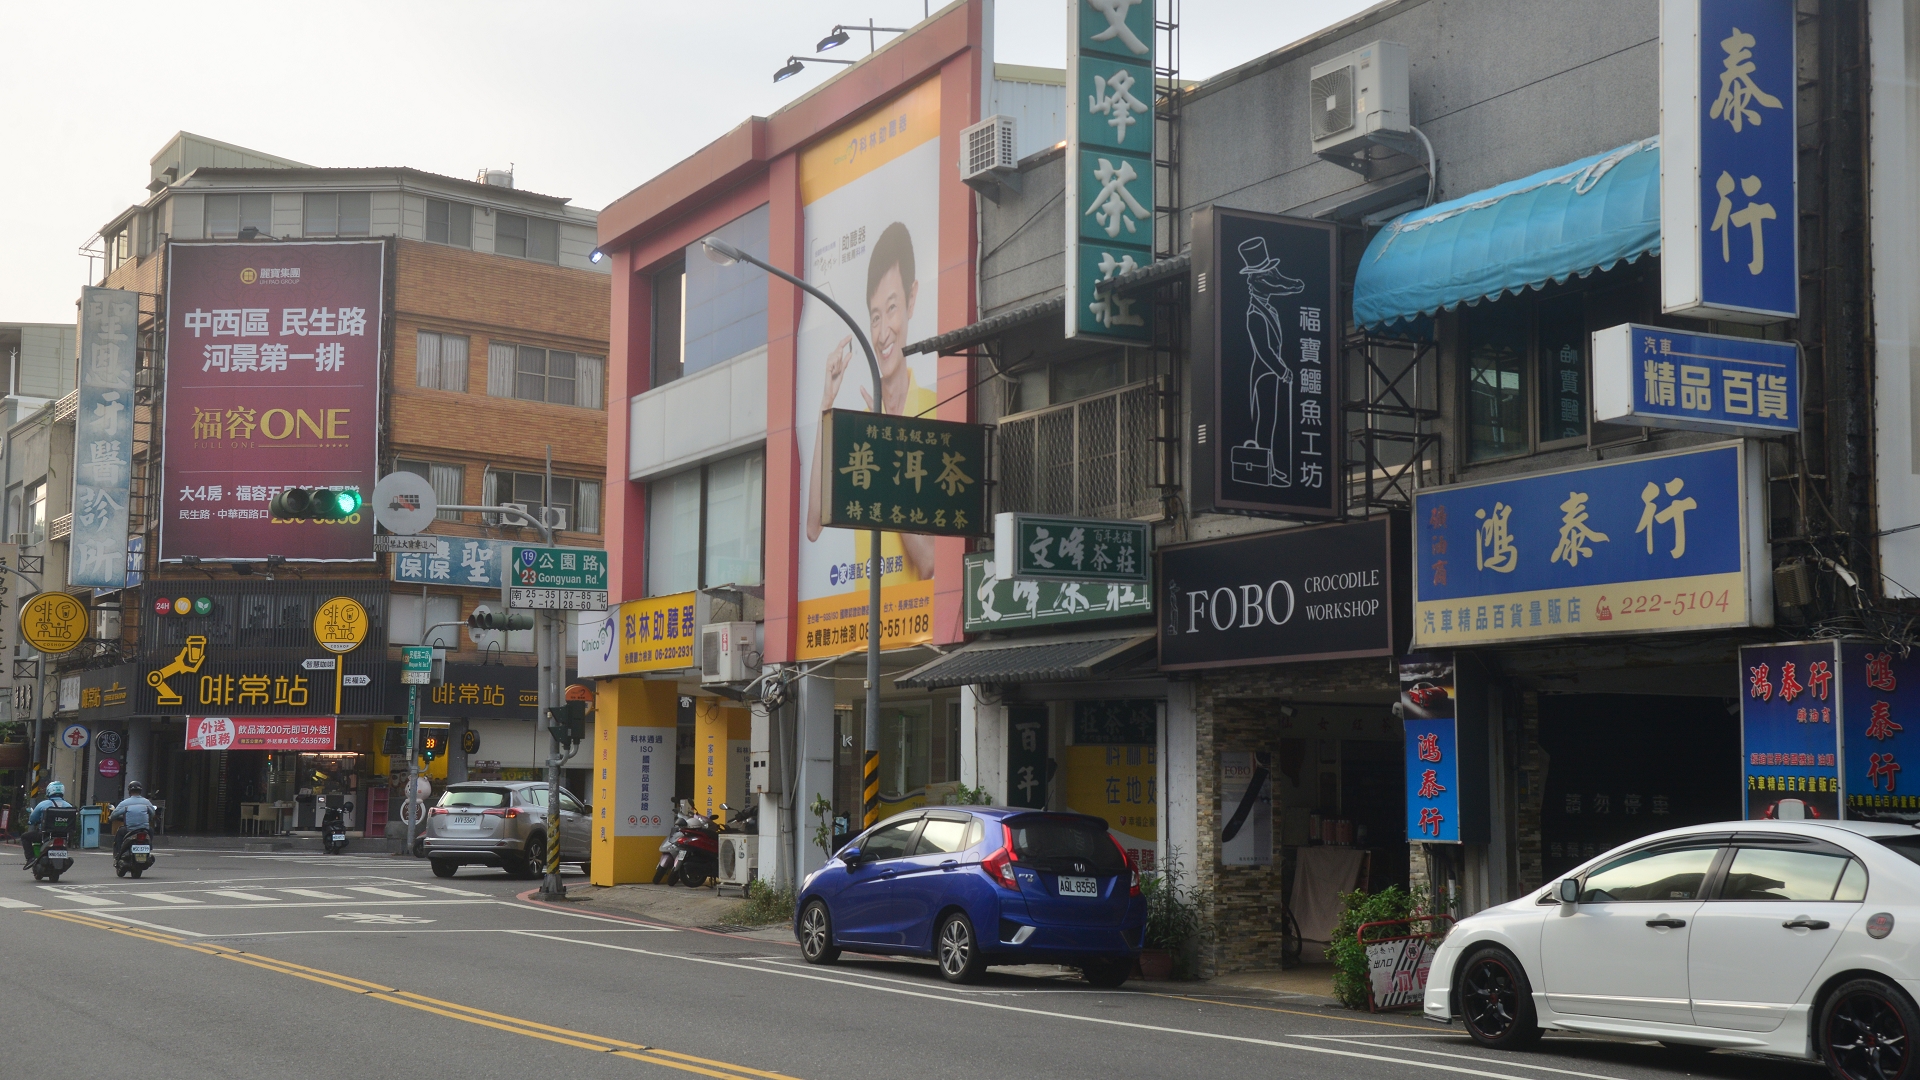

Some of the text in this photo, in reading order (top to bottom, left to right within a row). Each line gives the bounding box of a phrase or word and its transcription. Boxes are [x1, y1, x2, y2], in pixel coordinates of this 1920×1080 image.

[1709, 26, 1784, 276] 泰行
[184, 307, 367, 338] 中西區 民生路
[202, 343, 345, 373] 河景第一排
[1644, 336, 1672, 356] 汽車
[1300, 306, 1322, 489] 福寶鱷魚工坊
[1644, 360, 1789, 420] 精品 百貨
[866, 424, 952, 448] 精選高級品質
[839, 441, 975, 497] 普洱茶
[846, 500, 969, 530] 特選各地名茶
[1475, 477, 1698, 574] 鴻泰行
[524, 551, 534, 561] 19
[539, 553, 599, 571] 公園路
[521, 569, 537, 584] 23
[538, 572, 599, 585] Gongyuan Rd.
[1304, 569, 1380, 594] CROCODILE
[156, 602, 170, 610] 24H
[512, 589, 522, 600] 南
[596, 593, 606, 603] 北
[1621, 589, 1730, 617] 222-5104
[1186, 580, 1295, 634] FOBO
[1305, 598, 1380, 621] WORKSHOP
[1423, 596, 1582, 635] 汽車精品百貨量販店
[625, 604, 694, 646] 科林助聽器
[806, 621, 857, 648] 免費聽力檢測
[859, 613, 929, 641] 080-551188
[654, 644, 693, 661] 06-220-2931
[200, 674, 308, 706] 啡常站
[1750, 660, 1833, 702] 鴻泰行
[432, 682, 505, 706] 啡常站
[201, 719, 226, 734] 外送
[238, 725, 332, 735] 飲品滿200元即可外送!
[1864, 651, 1904, 792] 鴻泰行
[205, 732, 231, 748] 服務
[289, 737, 331, 745] 06-2636789
[426, 737, 435, 749] 33
[630, 734, 663, 744] 科林通過
[640, 745, 653, 753] ISO
[1224, 765, 1251, 776] FOBO
[1417, 732, 1446, 837] 鴻泰行
[1748, 776, 1838, 793] 汽車精品百貨量販店
[1373, 958, 1393, 970] 出入口
